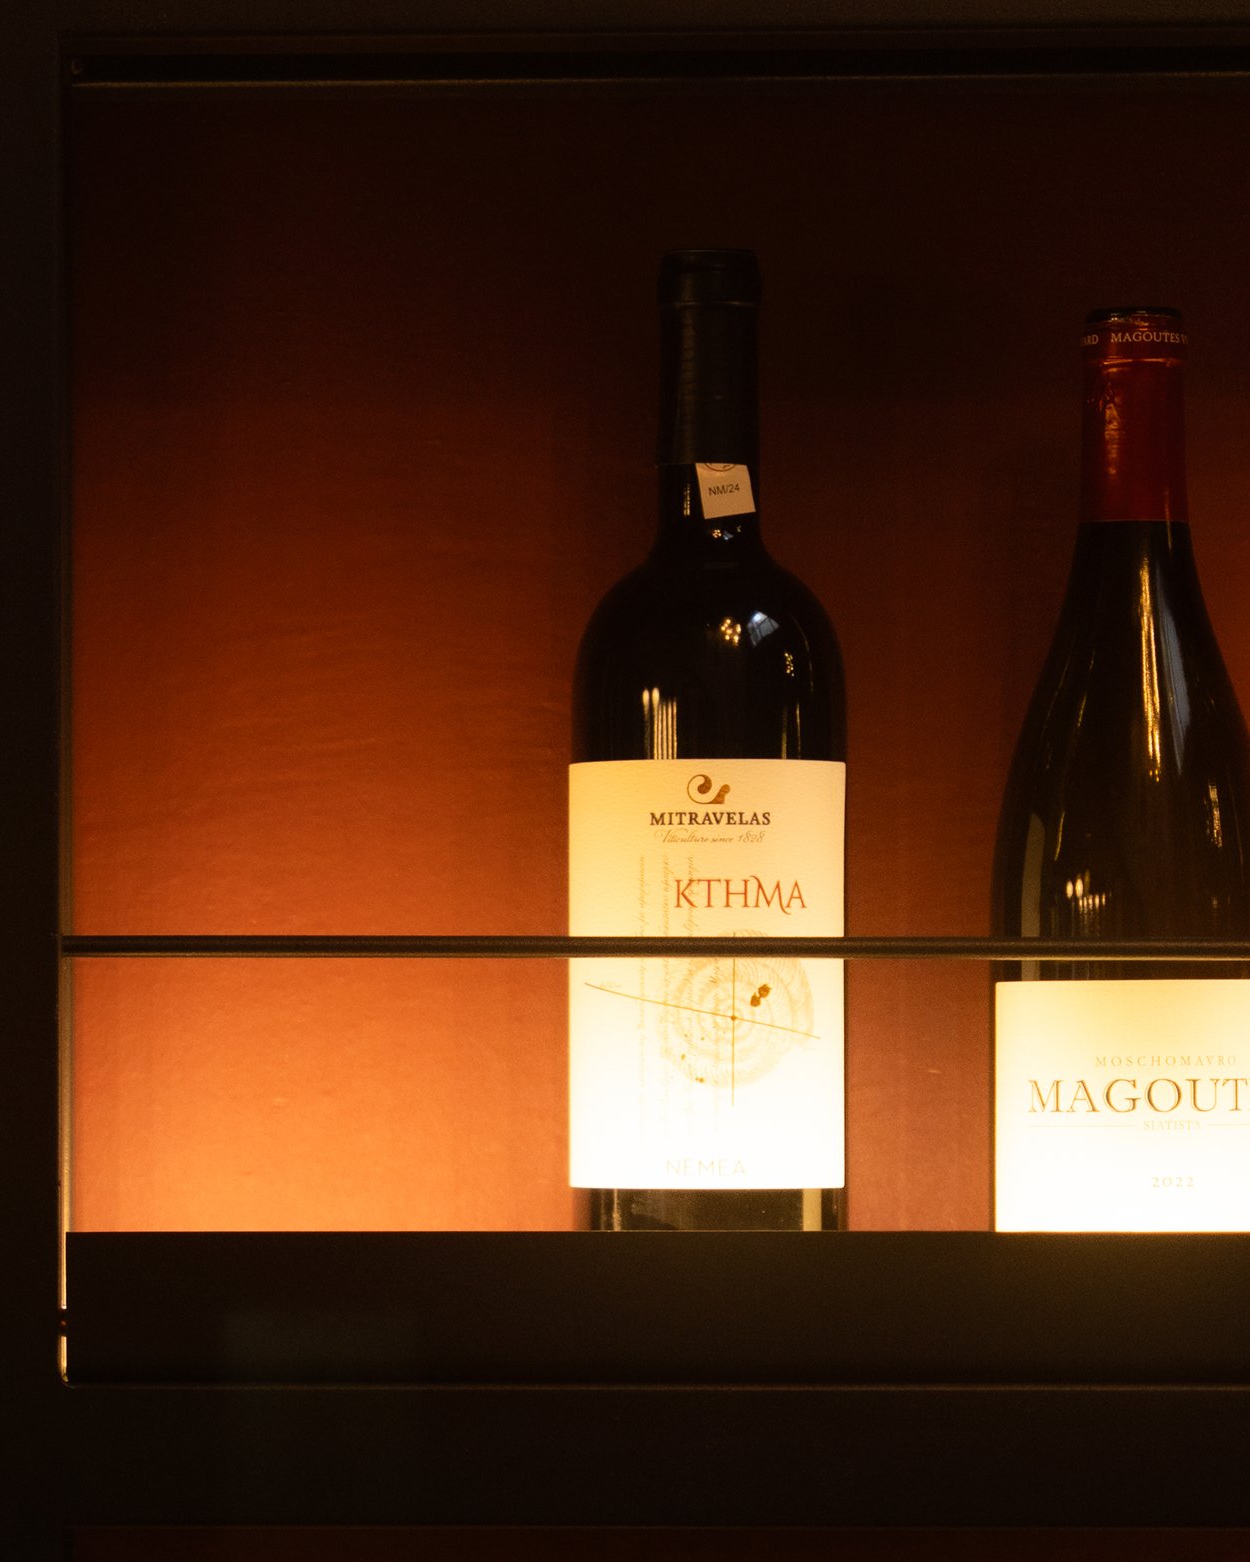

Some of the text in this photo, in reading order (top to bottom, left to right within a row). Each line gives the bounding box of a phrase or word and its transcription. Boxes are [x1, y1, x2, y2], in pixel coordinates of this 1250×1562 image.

[1110, 331, 1180, 343] MAGOUTES
[708, 483, 740, 497] NM/24
[650, 812, 771, 826] MITRAVELAS
[654, 828, 766, 843] Viticulture since 1828
[1094, 1055, 1237, 1067] MOSCHOMAVRO
[1028, 1077, 1250, 1114] MAGOUT
[1143, 1120, 1202, 1131] SIATISTA
[665, 1158, 747, 1177] NEMEA
[1152, 1176, 1195, 1188] 2022
